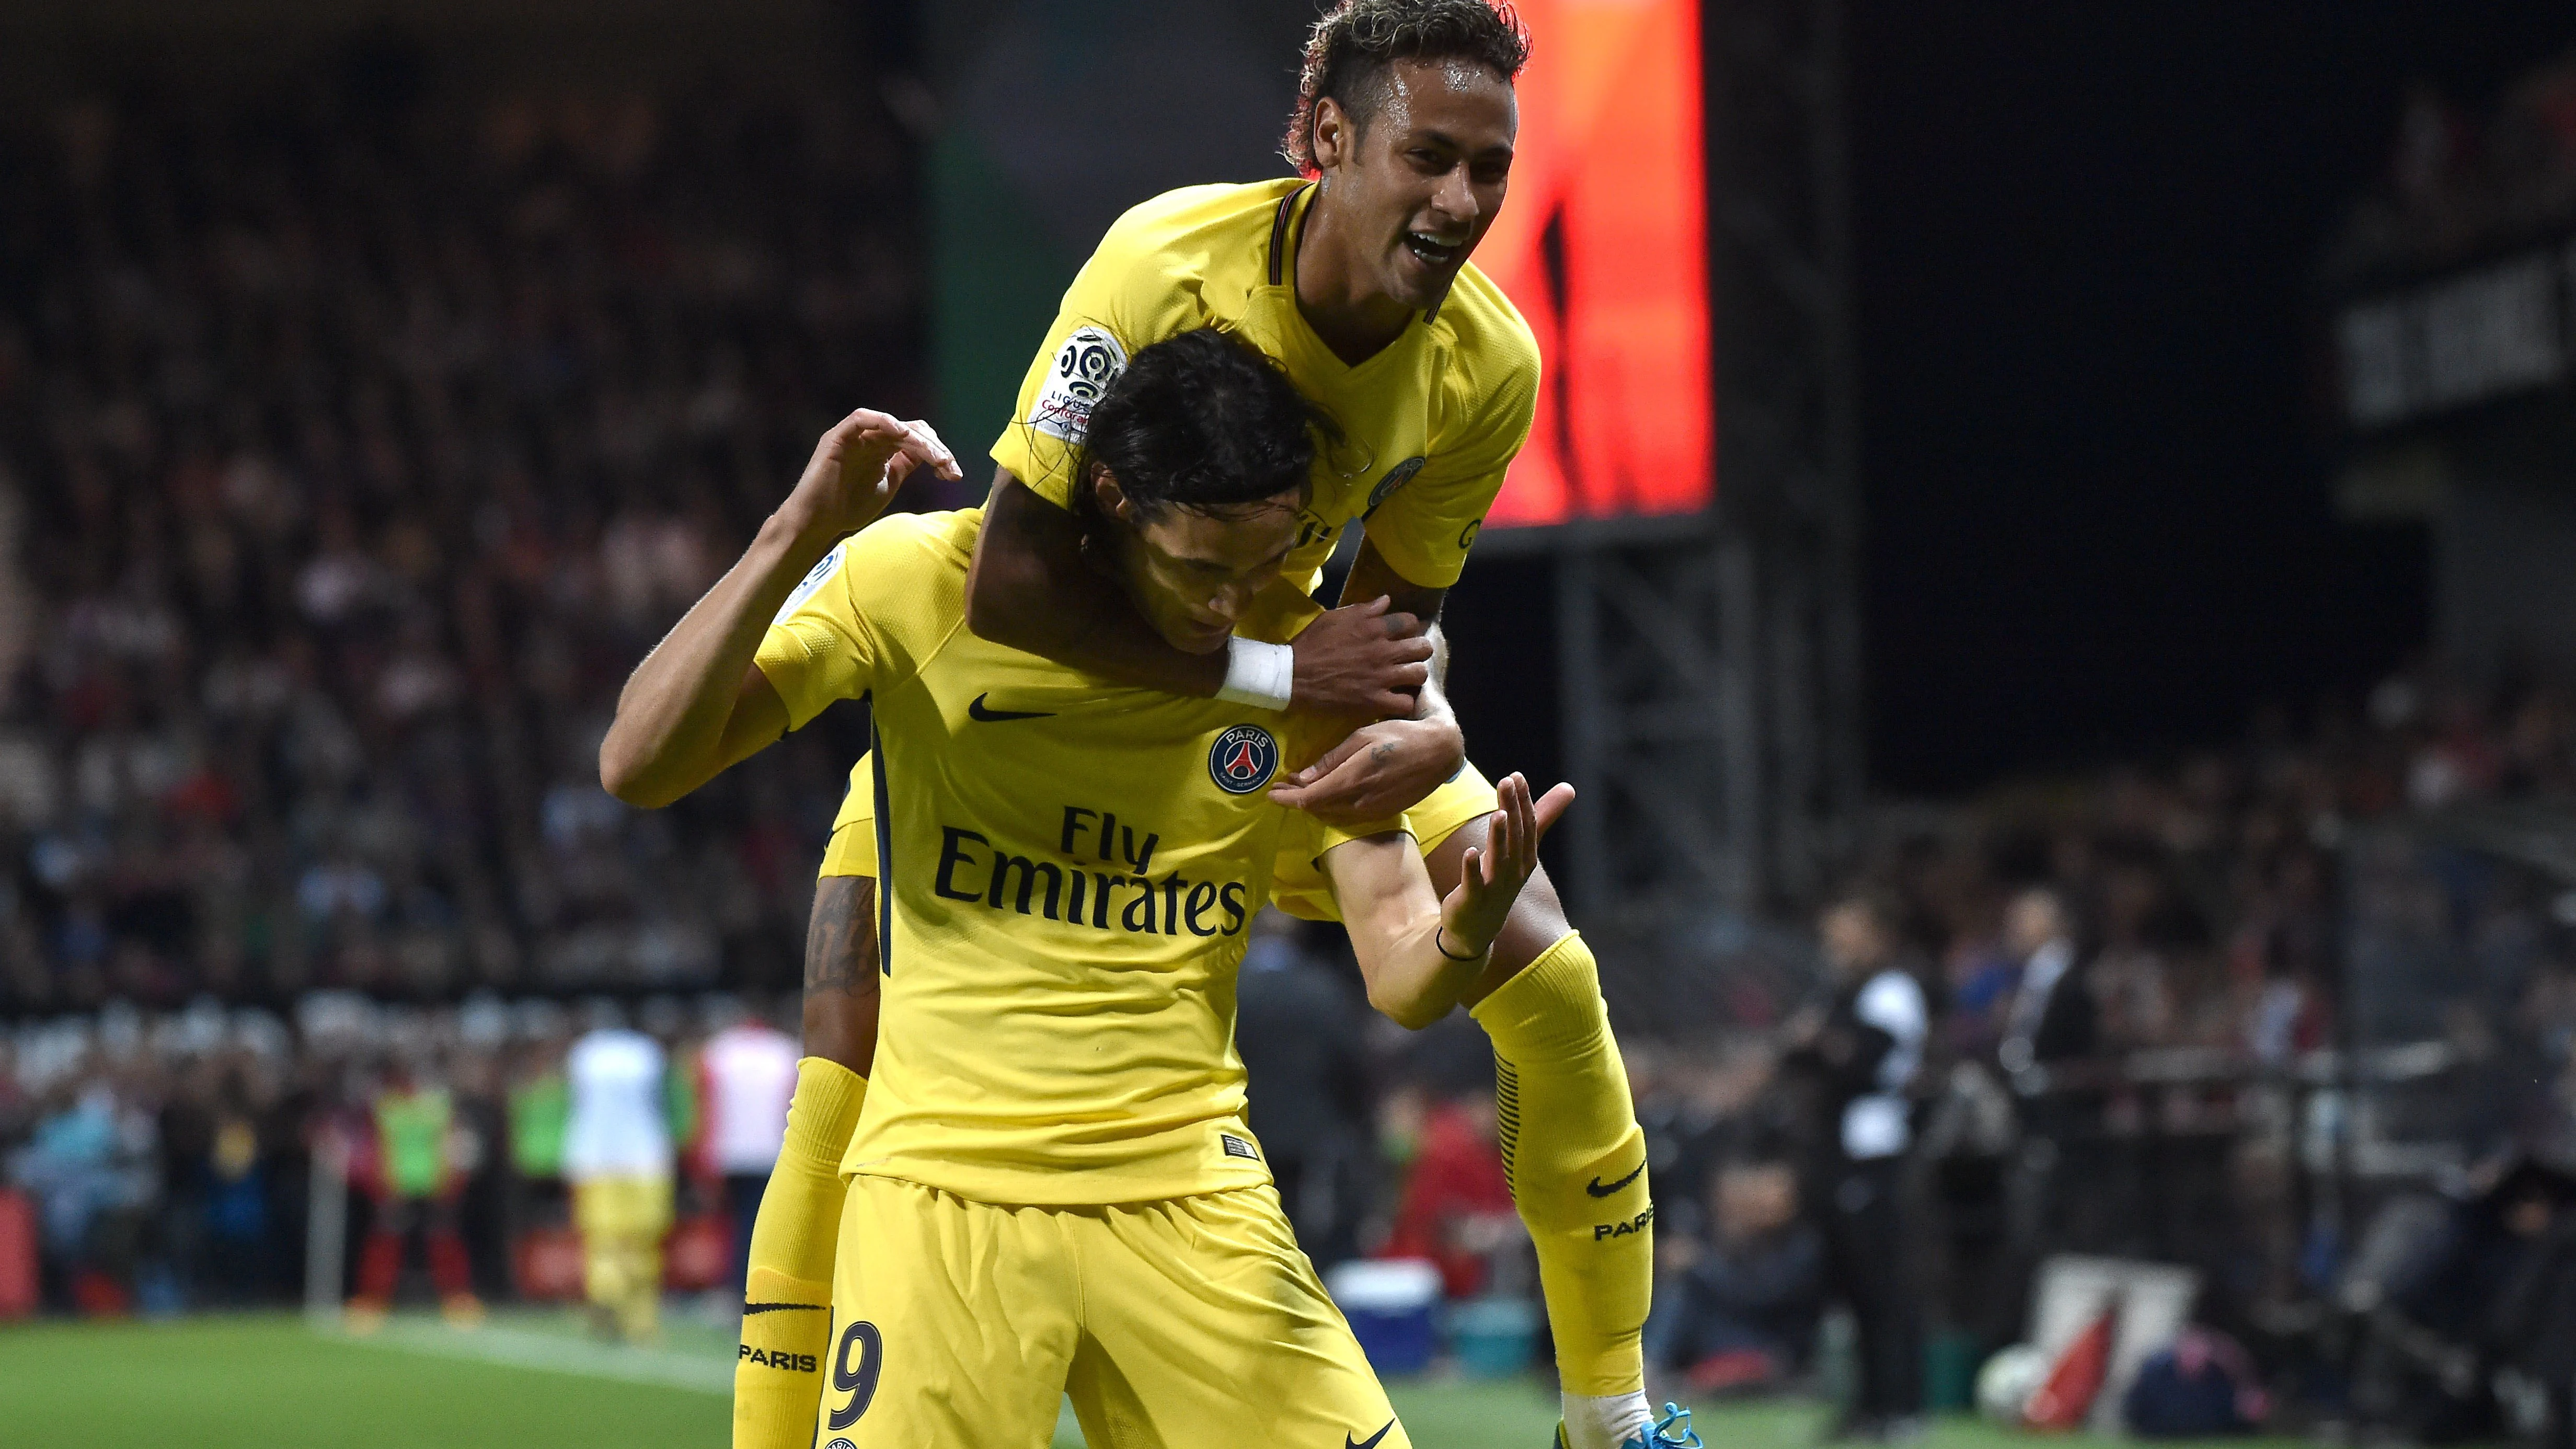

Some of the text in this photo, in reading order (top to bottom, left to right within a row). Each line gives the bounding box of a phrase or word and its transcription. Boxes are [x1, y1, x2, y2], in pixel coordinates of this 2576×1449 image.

[1226, 730, 1269, 748] PARIS
[1061, 806, 1159, 875] Fly
[935, 825, 1246, 936] Emirates
[739, 1344, 816, 1373] PARIS
[828, 1321, 882, 1431] 9
